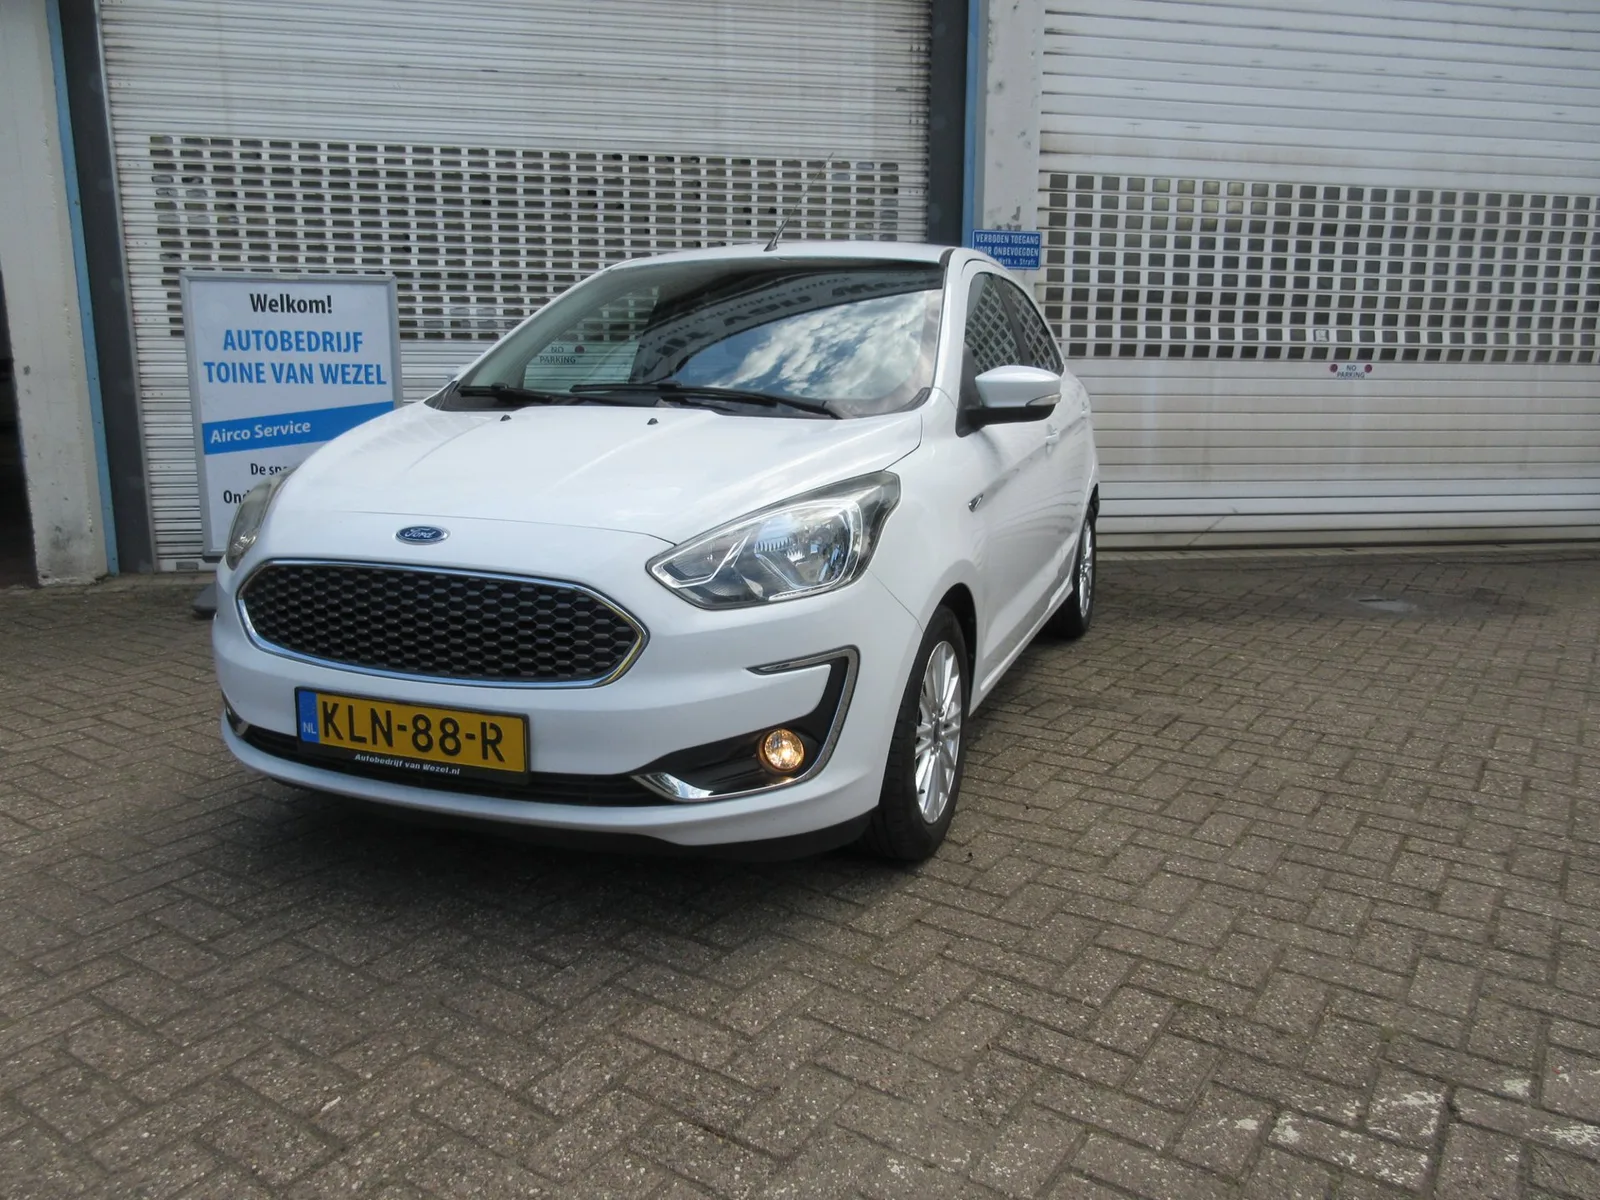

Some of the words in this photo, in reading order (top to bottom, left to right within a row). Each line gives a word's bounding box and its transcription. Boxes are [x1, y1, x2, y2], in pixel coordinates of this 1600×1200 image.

[975, 233, 1009, 243] VERBODEN
[1011, 235, 1039, 245] TOEGANG
[994, 247, 1039, 256] ONBEVOEGDEN
[249, 293, 333, 314] Welkom!
[223, 329, 363, 353] AUTOBEDRIJF
[539, 356, 576, 364] PARKING
[203, 361, 266, 384] TOINE
[270, 362, 314, 384] VAN
[319, 363, 387, 385] WEZEL
[210, 429, 251, 444] Airco
[254, 421, 311, 438] Service
[250, 463, 266, 475] De
[404, 528, 437, 539] Ford
[303, 722, 317, 735] NL
[322, 701, 505, 763] KLN-88-R
[355, 753, 403, 767] Autobedrijf
[405, 761, 421, 770] van
[422, 763, 460, 775] Wezel.nl
